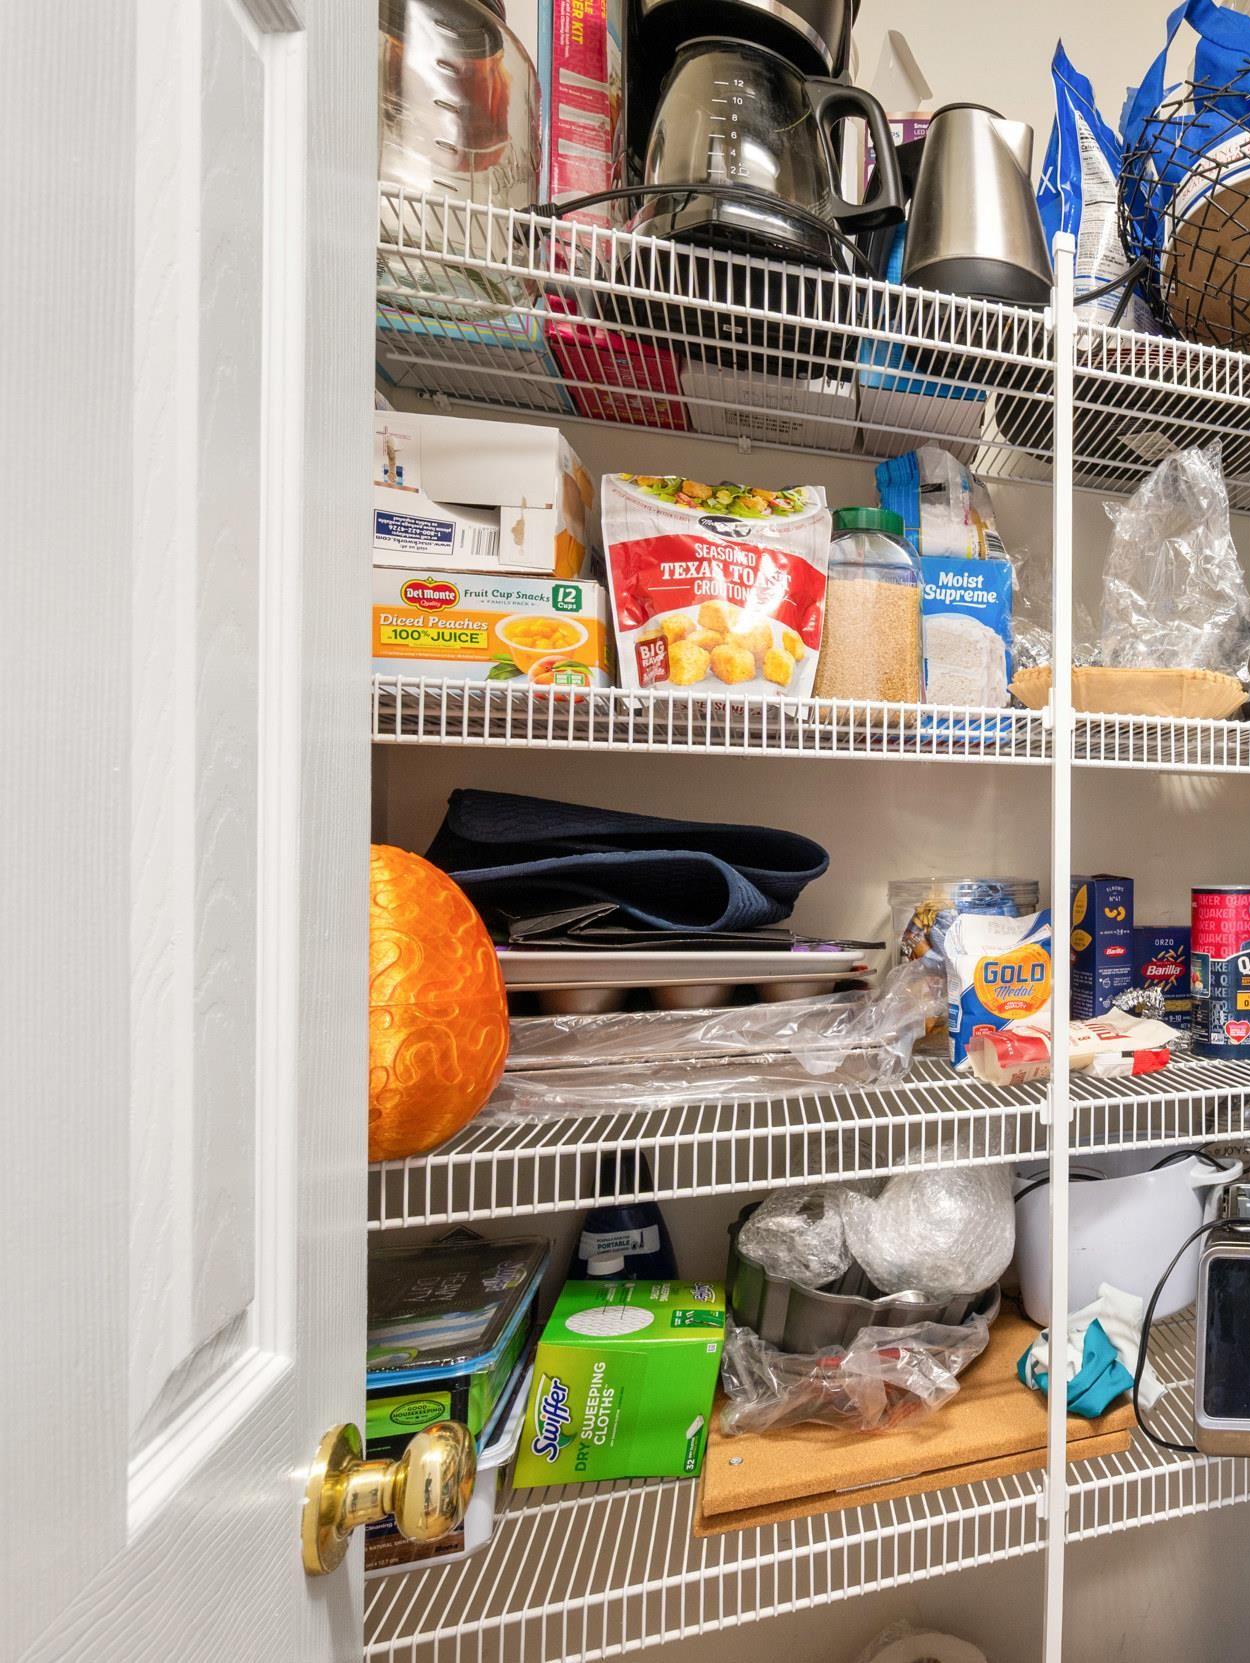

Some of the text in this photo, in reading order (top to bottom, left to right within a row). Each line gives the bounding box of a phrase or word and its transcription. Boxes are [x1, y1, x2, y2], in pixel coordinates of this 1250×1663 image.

[733, 79, 744, 88] 12
[732, 96, 743, 105] 10
[695, 543, 756, 566] SEASONED
[938, 571, 984, 589] Moist
[406, 588, 456, 601] Del Monte
[463, 588, 550, 603] Fruit Cup Snacks
[557, 587, 577, 603] 12
[557, 602, 577, 610] Cups
[379, 613, 488, 630] Diced Peaches
[392, 628, 480, 644] 100% JUICE
[639, 640, 665, 659] BIG
[1154, 938, 1174, 946] ORZO
[983, 960, 1045, 984] GOLD
[1146, 964, 1182, 976] Barilla
[993, 984, 1034, 1001] Medal
[597, 1239, 630, 1250] PORTABLE
[392, 1407, 443, 1419] HOUSEKEEPING
[531, 1377, 571, 1464] Swiffer
[574, 1361, 607, 1473] DRY SWEEPING
[593, 1390, 615, 1445] CLOTHS
